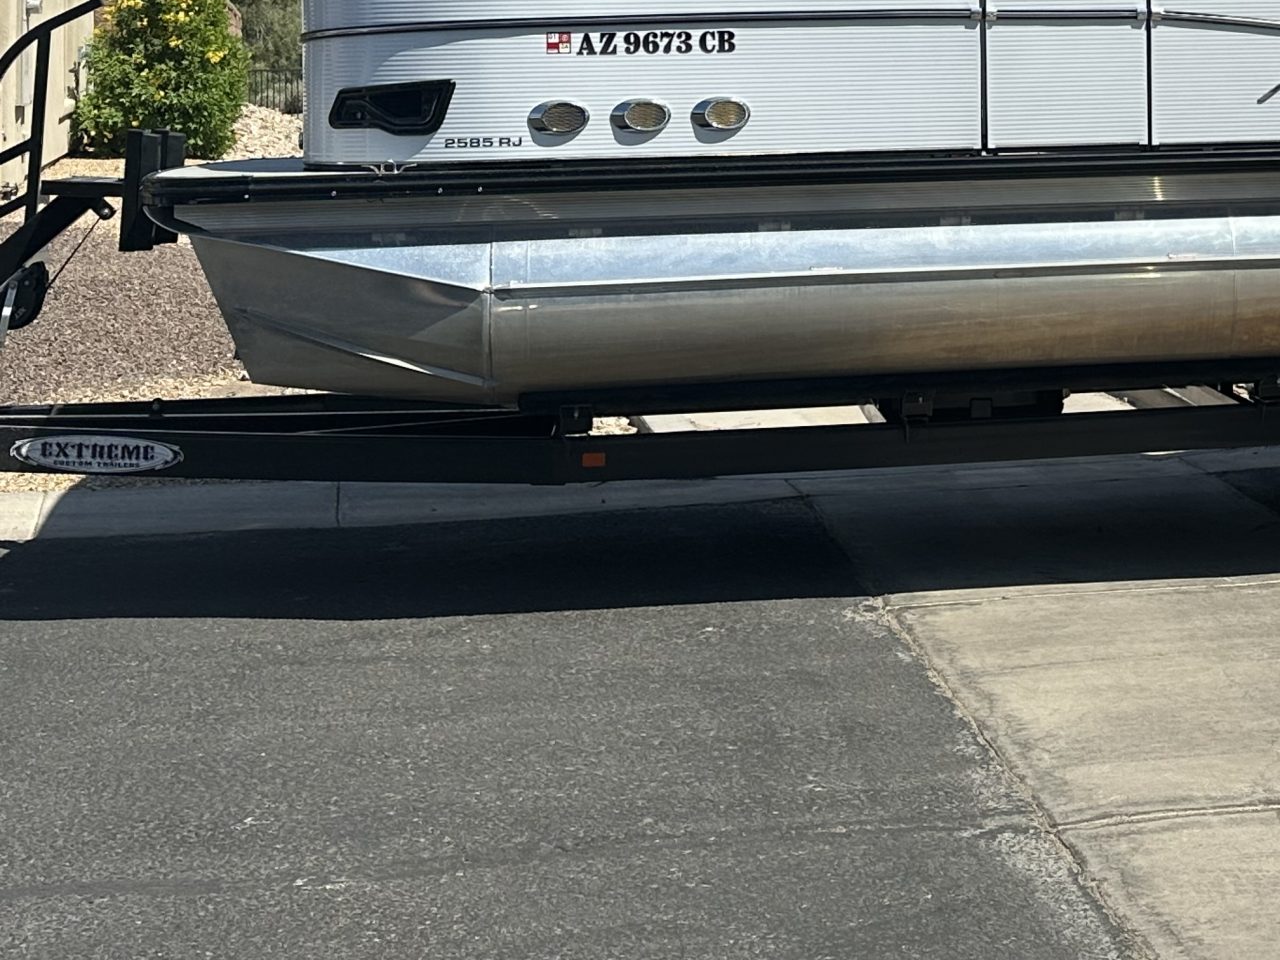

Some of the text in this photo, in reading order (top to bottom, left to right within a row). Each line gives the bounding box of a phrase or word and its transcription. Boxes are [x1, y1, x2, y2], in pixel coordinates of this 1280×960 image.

[576, 30, 736, 55] AZ 9673 CB
[444, 137, 523, 149] 2585 RJ
[40, 441, 156, 461] EXTREME
